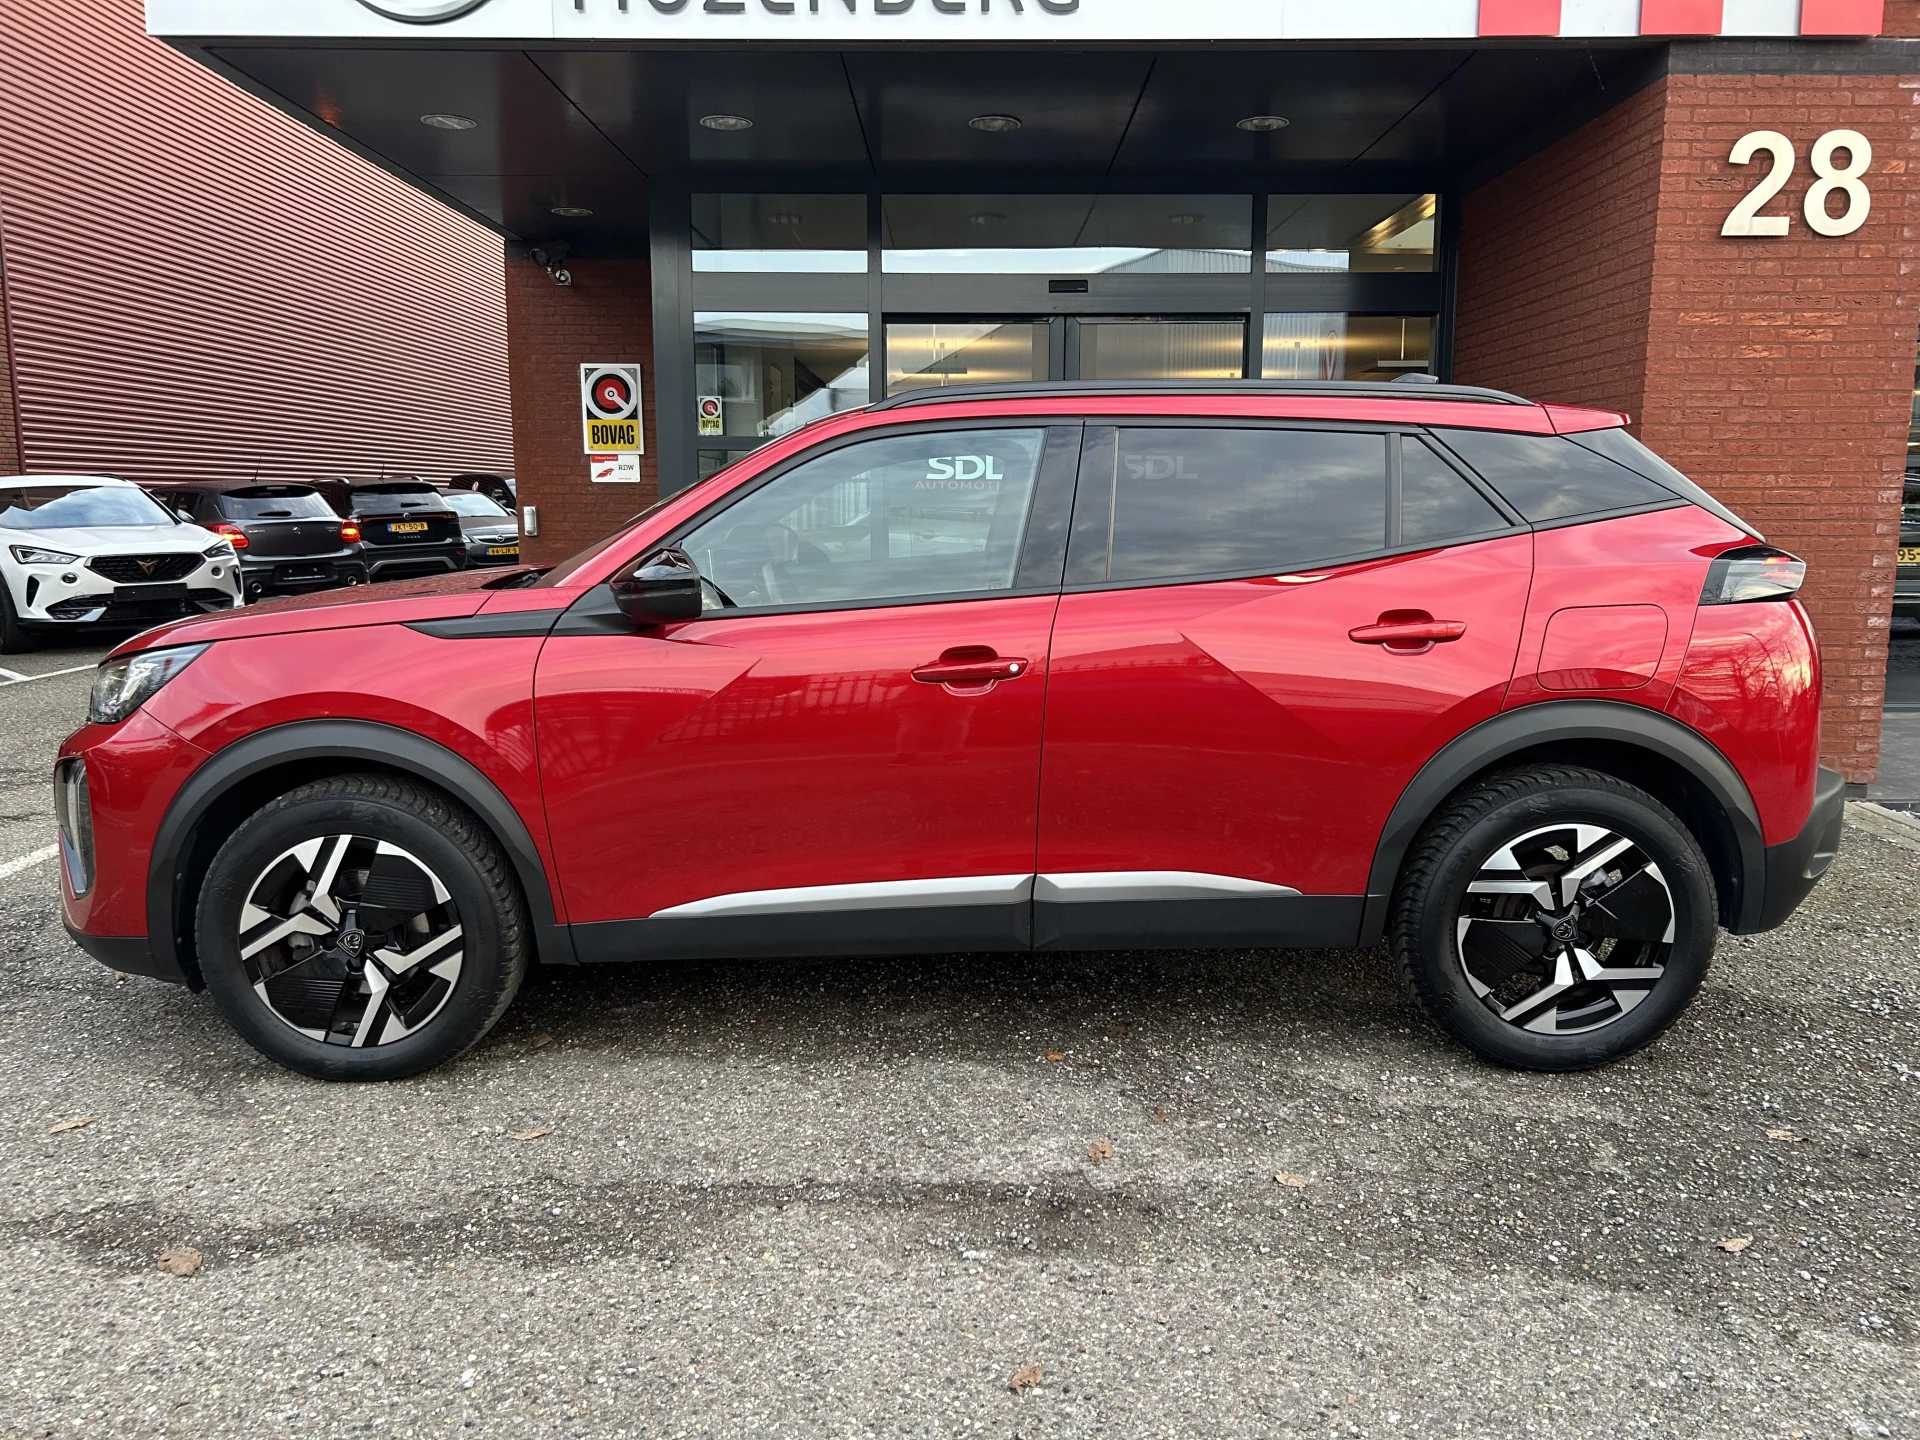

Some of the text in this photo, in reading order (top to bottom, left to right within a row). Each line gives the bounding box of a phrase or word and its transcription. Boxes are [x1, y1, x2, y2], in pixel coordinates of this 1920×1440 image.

[1721, 129, 1872, 236] 28
[591, 424, 635, 445] BOVAG
[926, 455, 1003, 480] SDL
[1124, 455, 1198, 480] SDL
